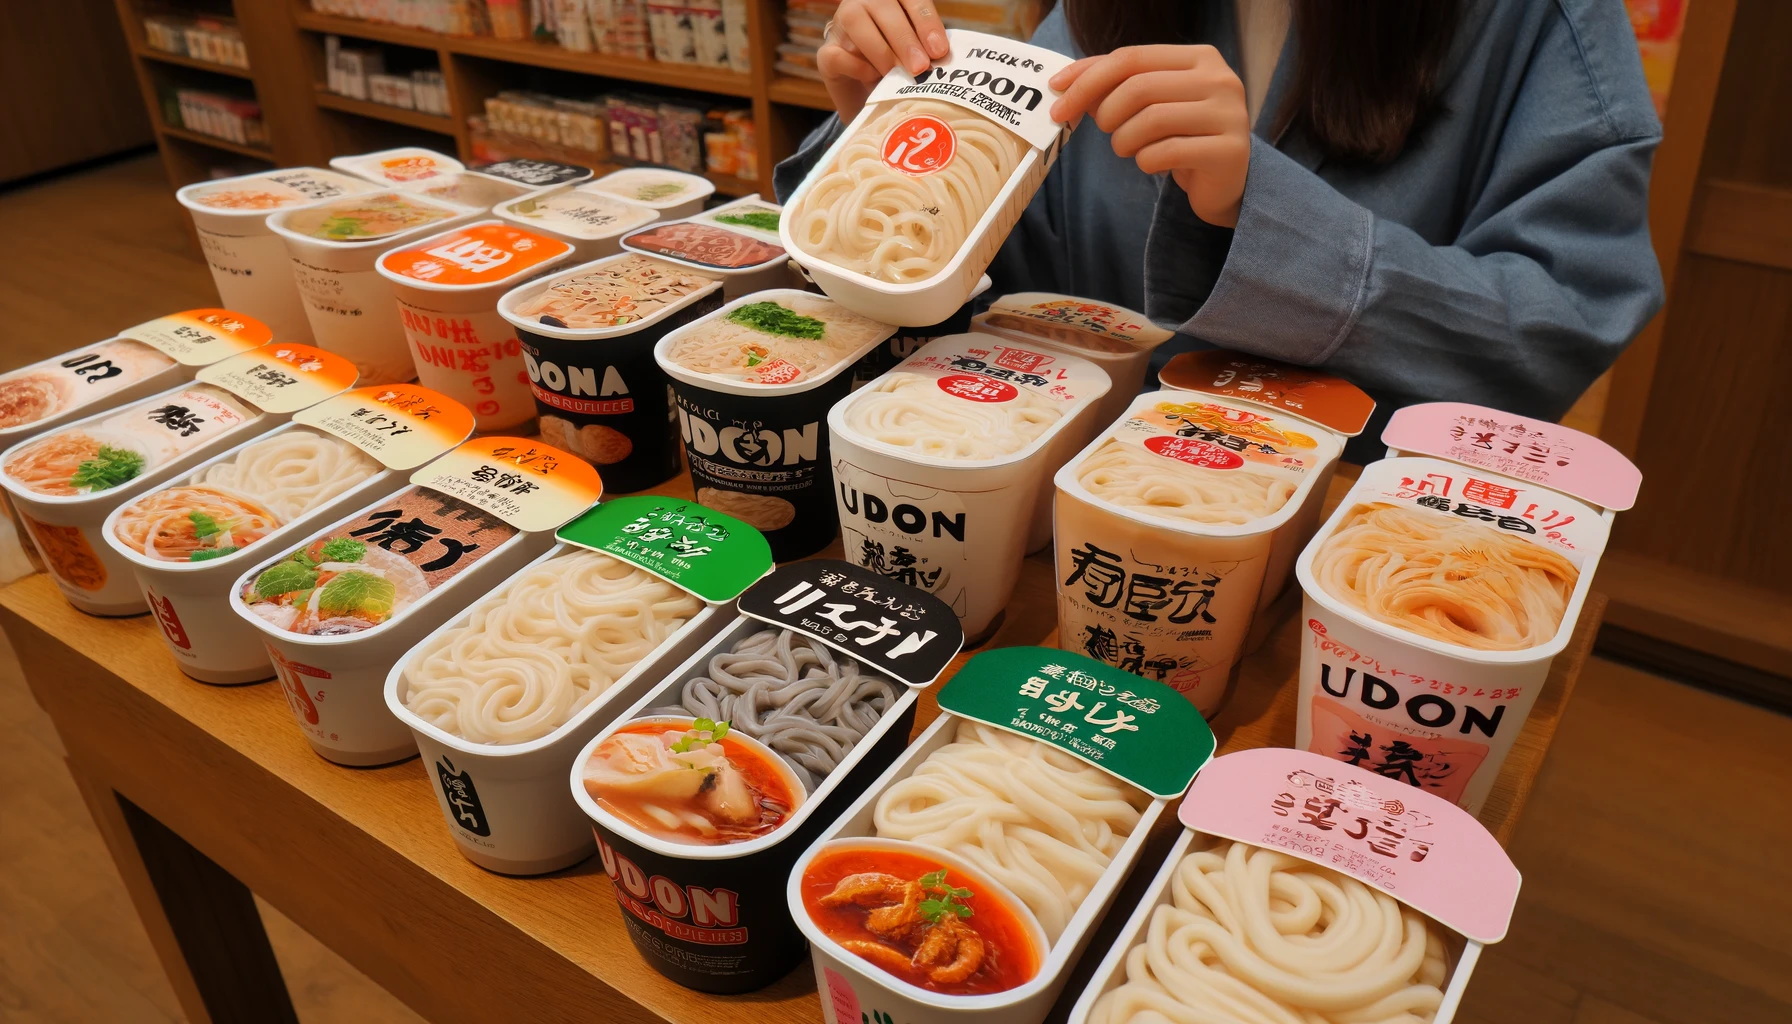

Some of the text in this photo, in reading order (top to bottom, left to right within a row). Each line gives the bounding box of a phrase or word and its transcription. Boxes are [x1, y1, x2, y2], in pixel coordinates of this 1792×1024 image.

[840, 481, 966, 542] UDON
[1321, 663, 1506, 738] UDON
[592, 824, 740, 927] UDON
